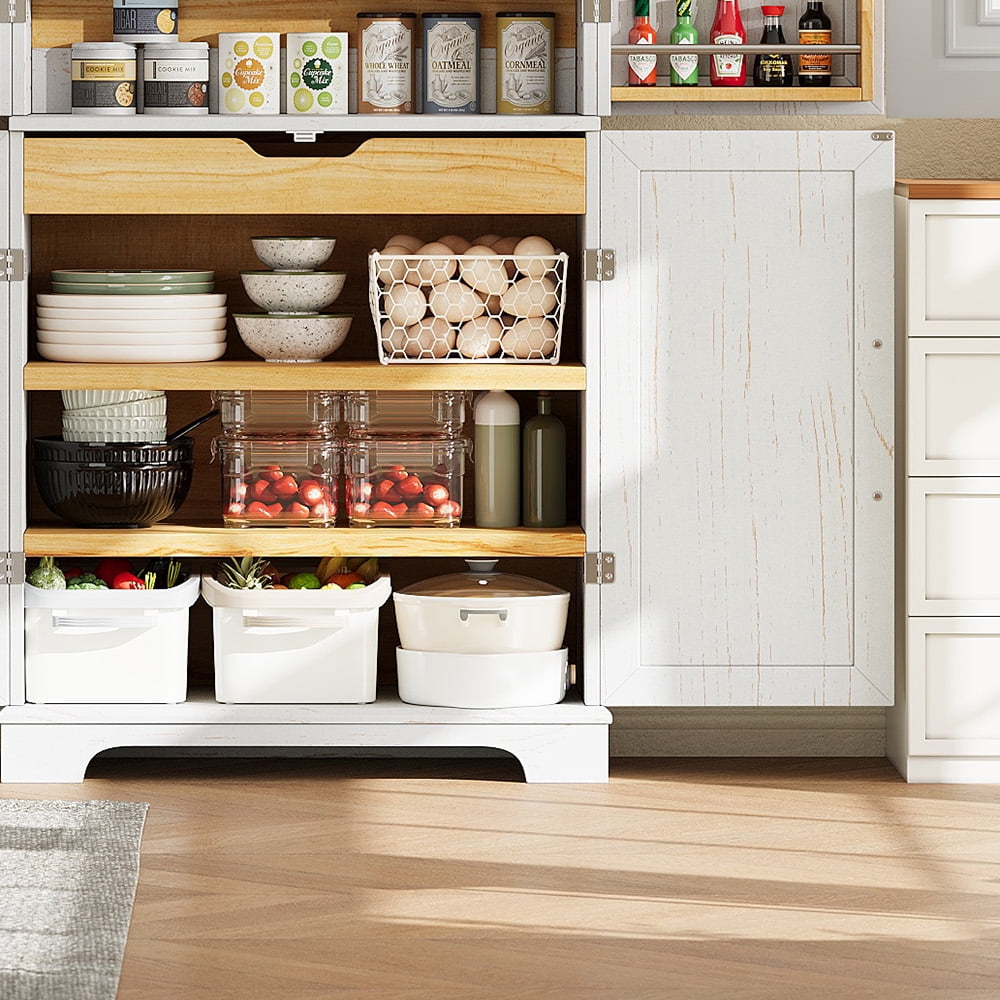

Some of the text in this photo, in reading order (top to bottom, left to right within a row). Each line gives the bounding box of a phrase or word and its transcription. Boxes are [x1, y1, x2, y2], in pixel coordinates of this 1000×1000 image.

[365, 31, 405, 58] Organic
[430, 31, 470, 58] Organic
[504, 30, 544, 58] Organic
[630, 55, 656, 63] TABASCO
[671, 55, 697, 63] TABASCO
[431, 61, 472, 69] OATMEAL
[505, 60, 547, 69] CORNMEAL
